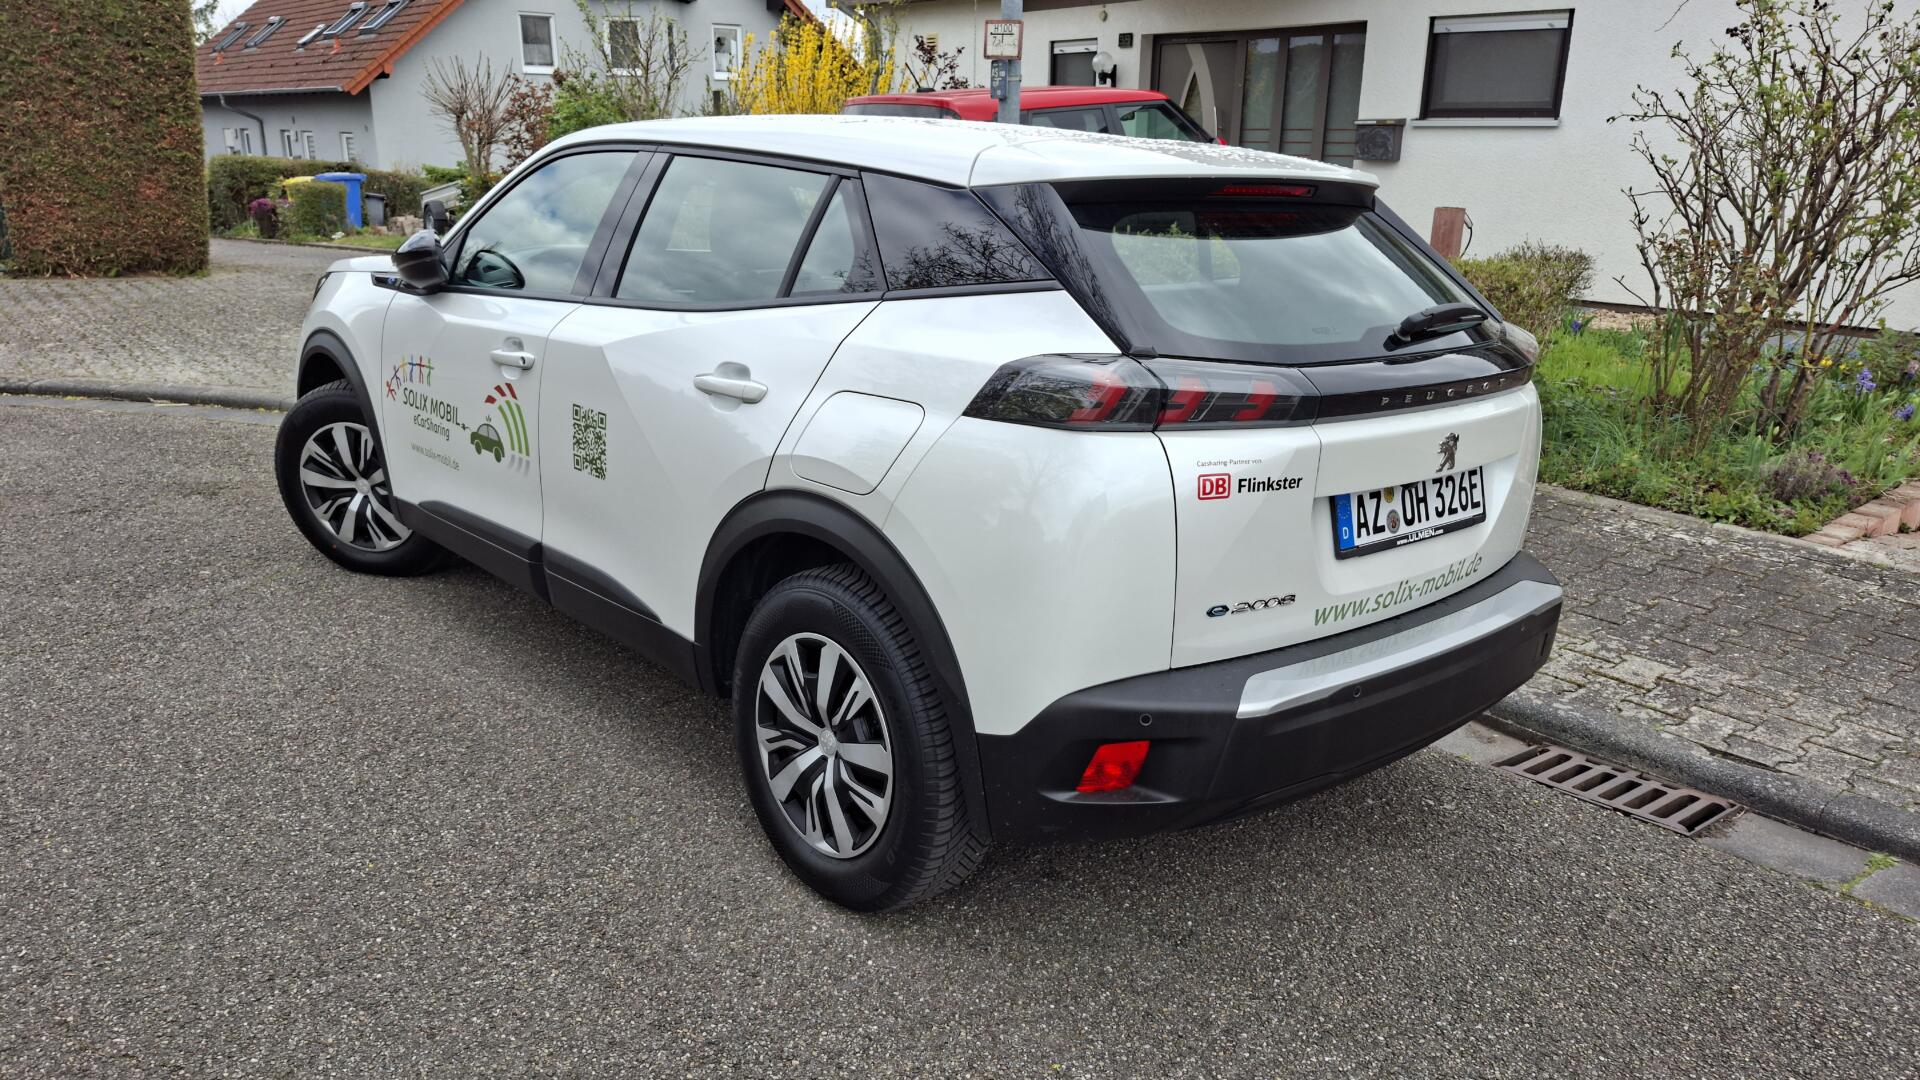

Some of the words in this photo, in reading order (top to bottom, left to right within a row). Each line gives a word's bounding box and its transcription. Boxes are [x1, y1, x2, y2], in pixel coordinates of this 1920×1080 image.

[403, 387, 429, 413] SOLIX
[430, 397, 461, 429] MOBIL
[1380, 378, 1505, 406] PEUGEOT
[413, 413, 450, 441] eCarSharing
[1201, 477, 1228, 496] DB
[1237, 477, 1303, 494] Flinkster
[1342, 526, 1350, 540] D
[1356, 490, 1386, 539] AZ
[1432, 469, 1481, 518] 326E
[1314, 552, 1483, 626] www.solix-mobil.de
